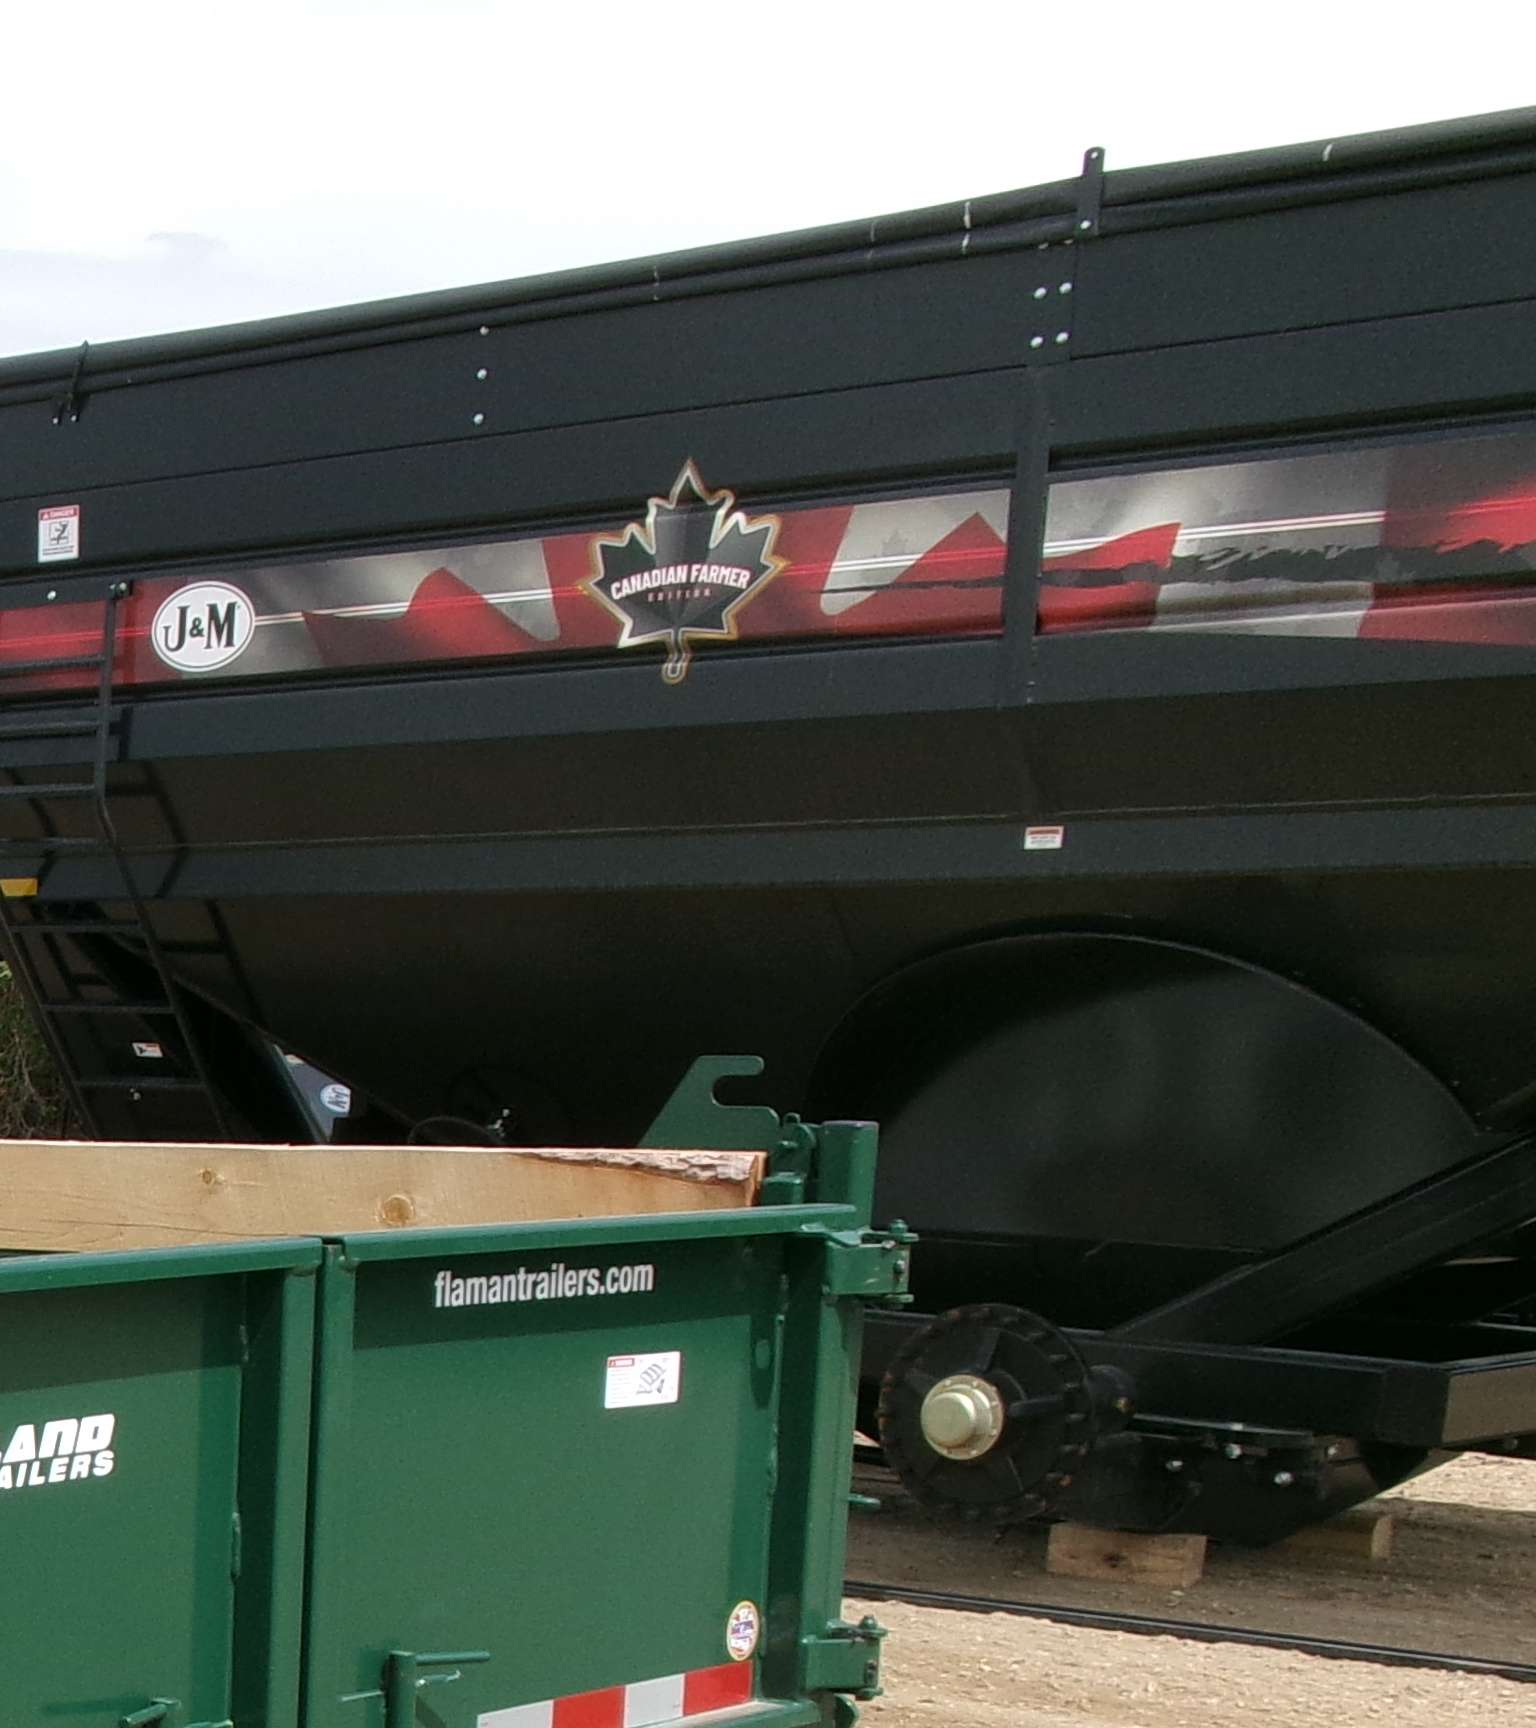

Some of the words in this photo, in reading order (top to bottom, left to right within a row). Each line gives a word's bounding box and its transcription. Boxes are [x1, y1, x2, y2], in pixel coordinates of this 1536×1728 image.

[610, 564, 688, 601] CANADIAN
[690, 563, 752, 590] FARMER
[162, 601, 238, 653] J&M
[434, 1260, 655, 1308] flamantrailers.com
